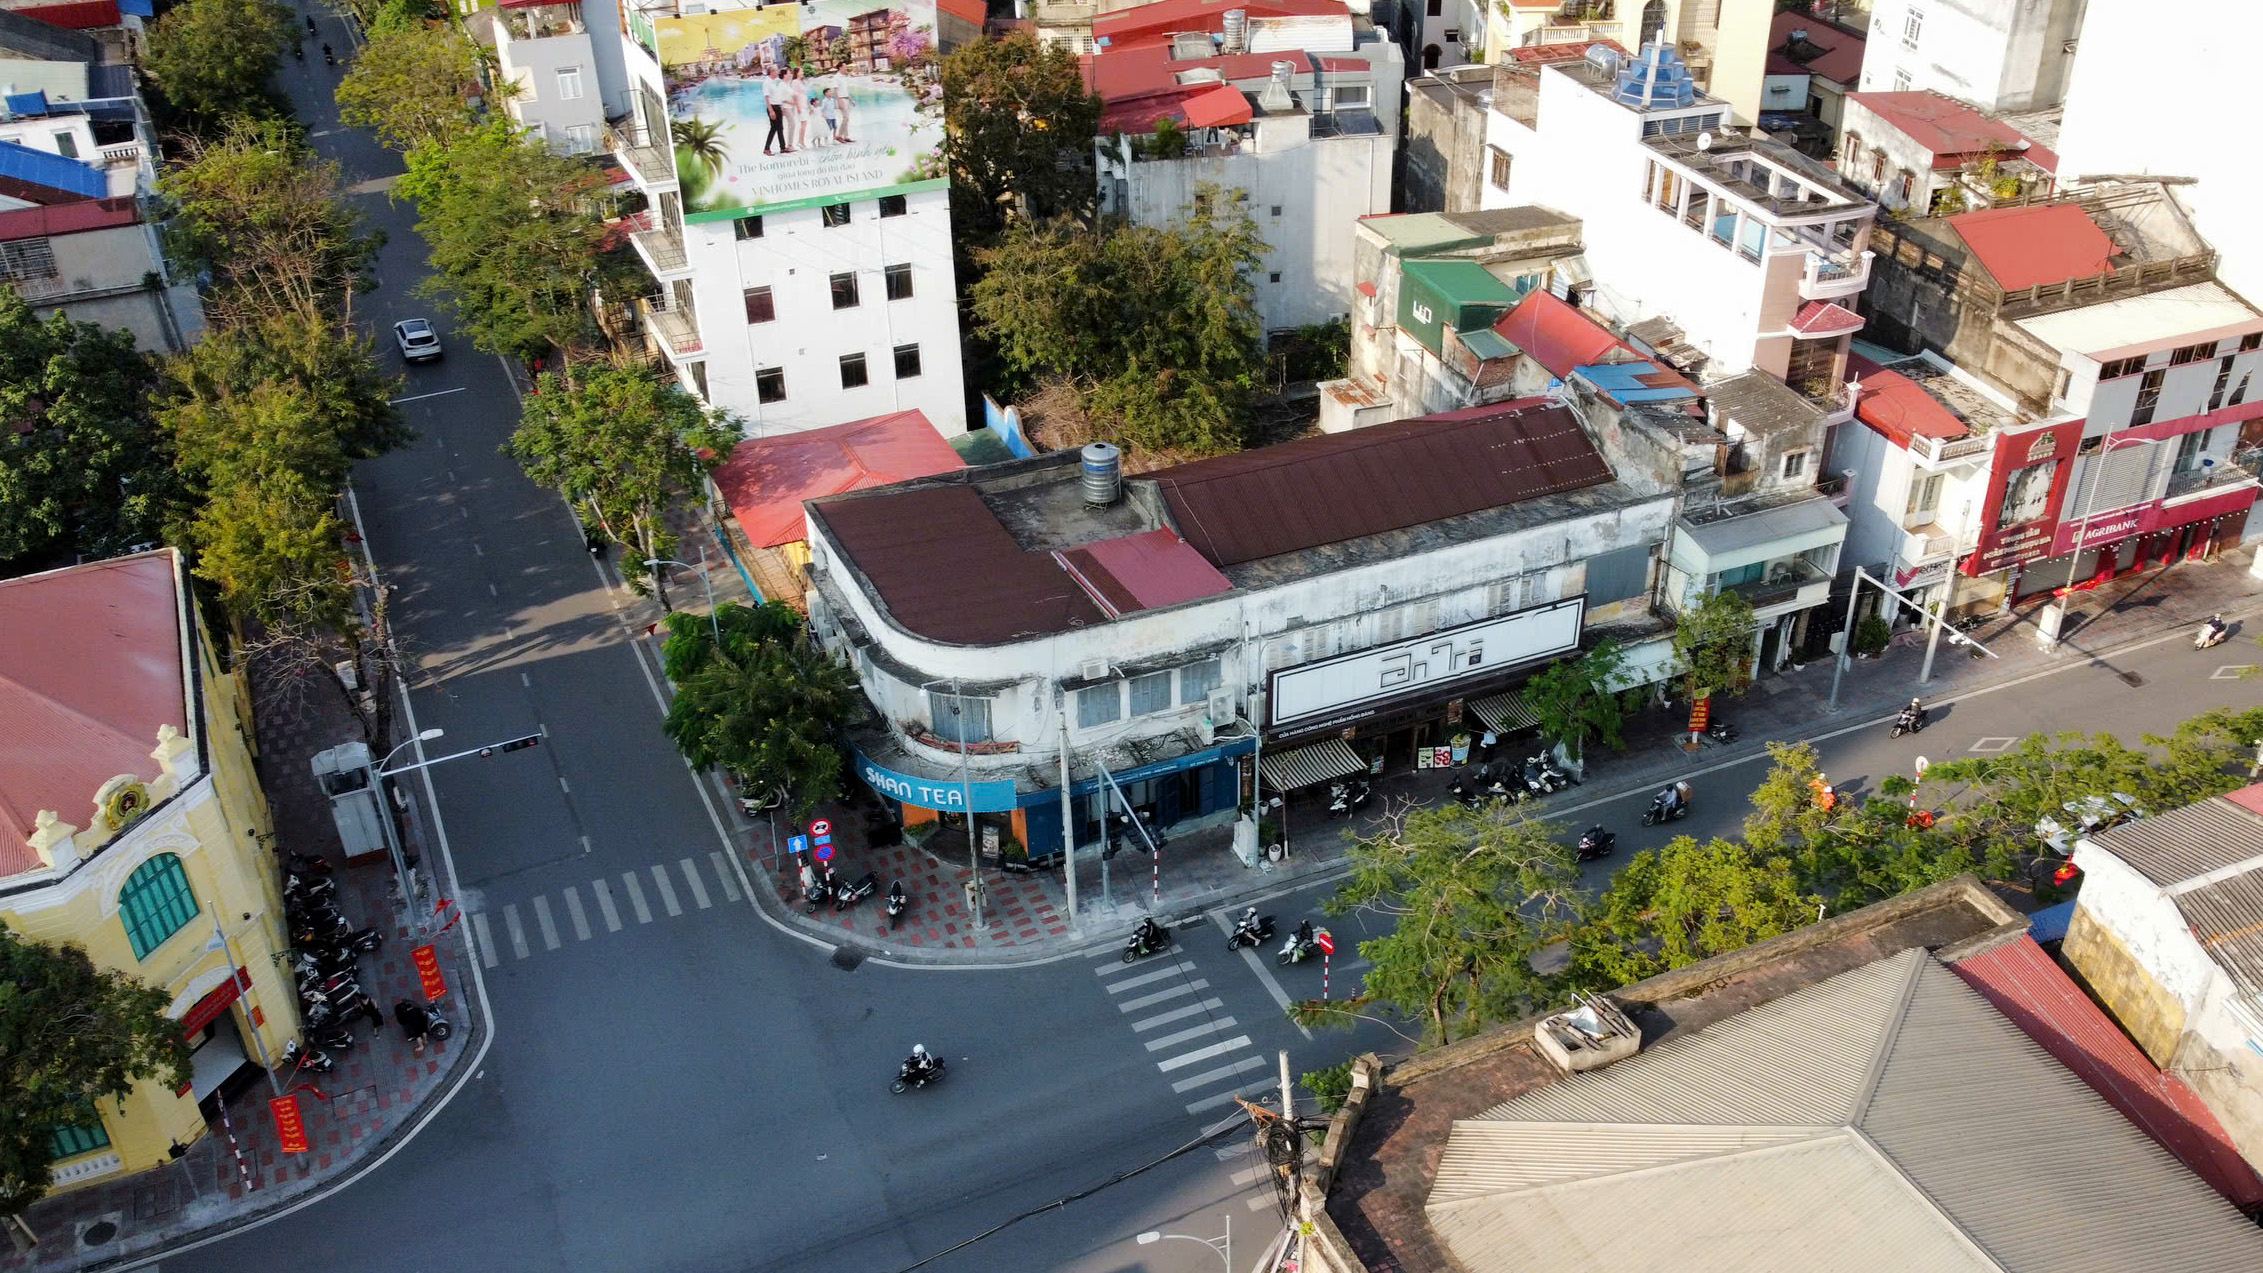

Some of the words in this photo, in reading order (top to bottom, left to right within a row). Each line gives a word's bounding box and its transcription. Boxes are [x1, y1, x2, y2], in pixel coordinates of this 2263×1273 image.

[738, 163, 757, 174] The
[752, 181, 809, 196] VINHOMES
[2084, 519, 2138, 540] AGRIBANK
[865, 767, 912, 799] SHAN
[919, 786, 963, 806] TEA
